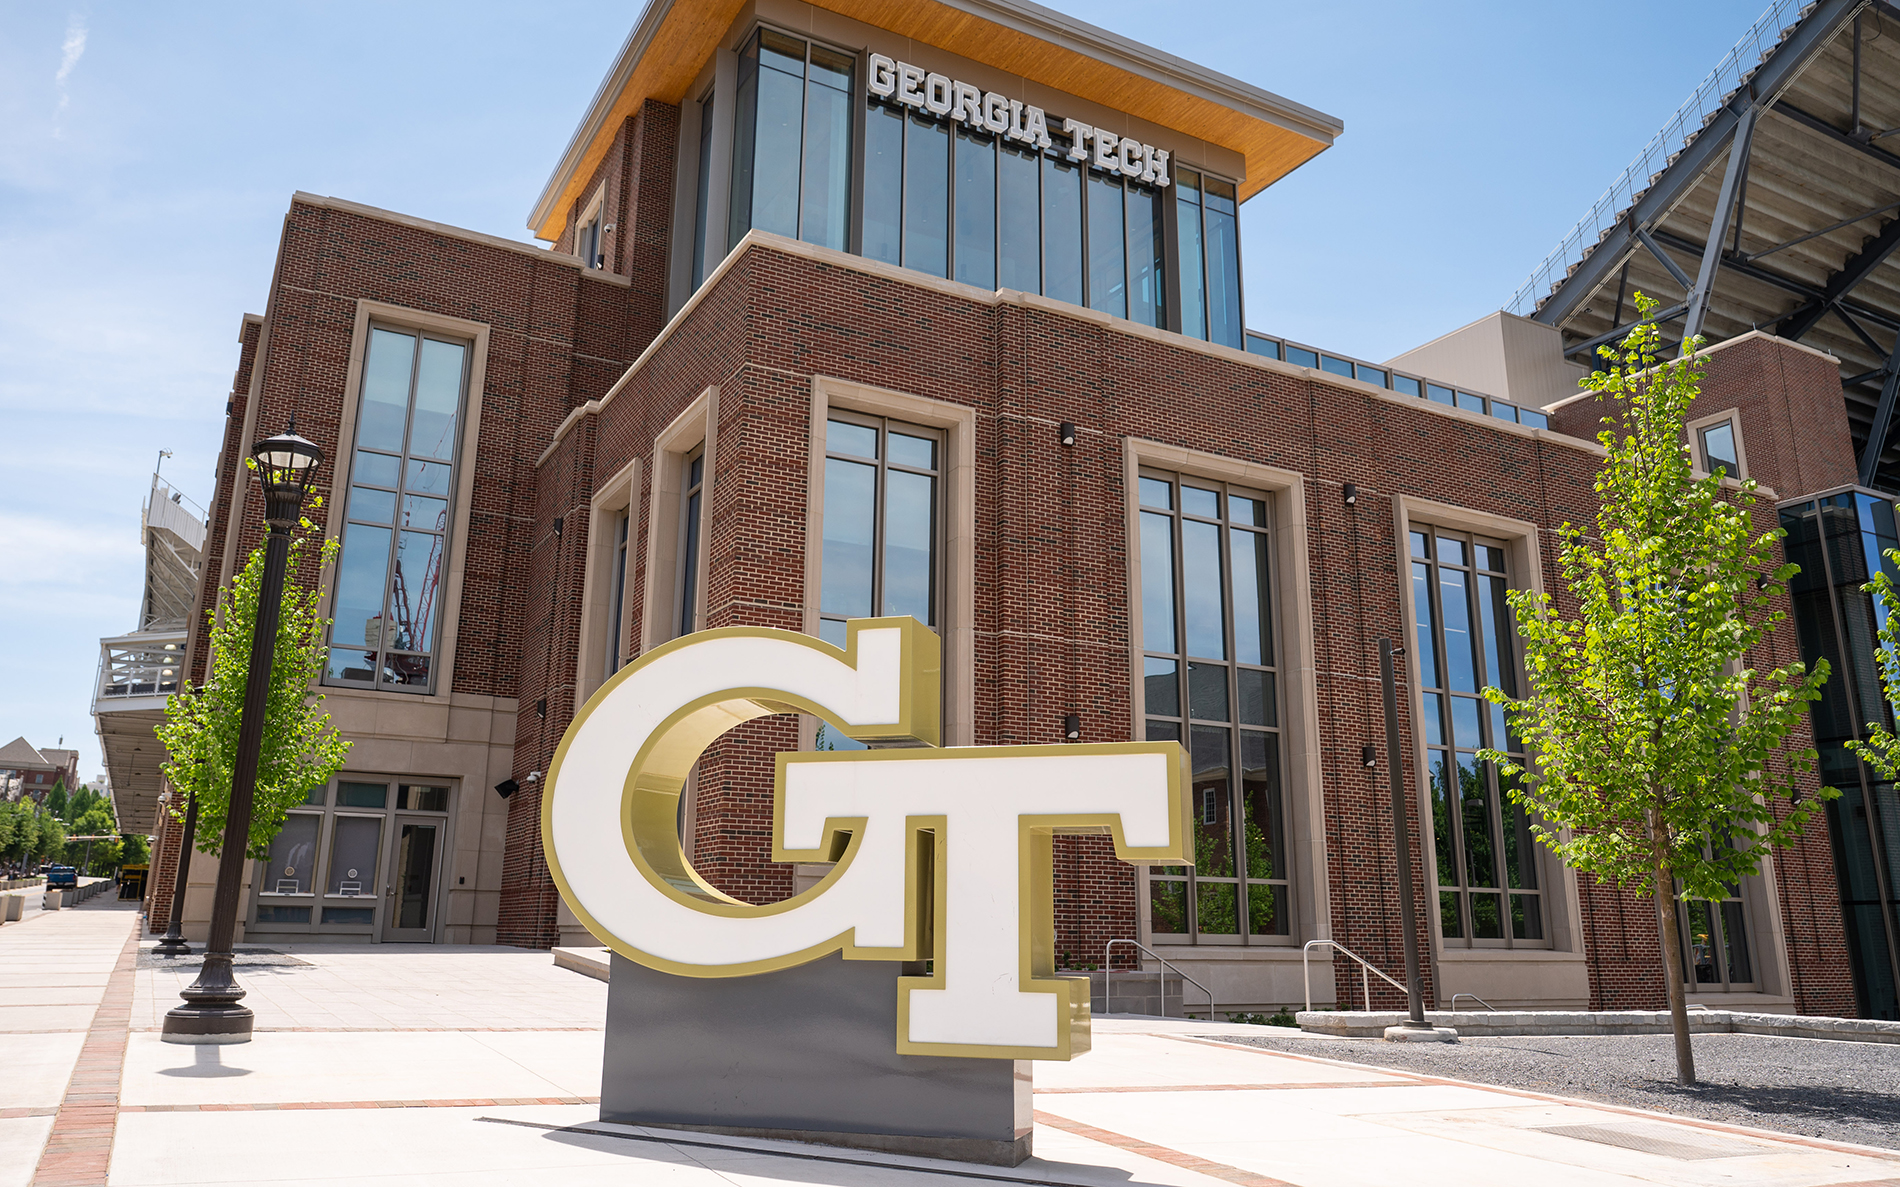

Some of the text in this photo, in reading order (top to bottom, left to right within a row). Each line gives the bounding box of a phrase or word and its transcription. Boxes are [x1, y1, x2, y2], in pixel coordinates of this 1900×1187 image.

[868, 52, 1171, 188] GEORGIA TECH
[541, 616, 1194, 1061] GT
